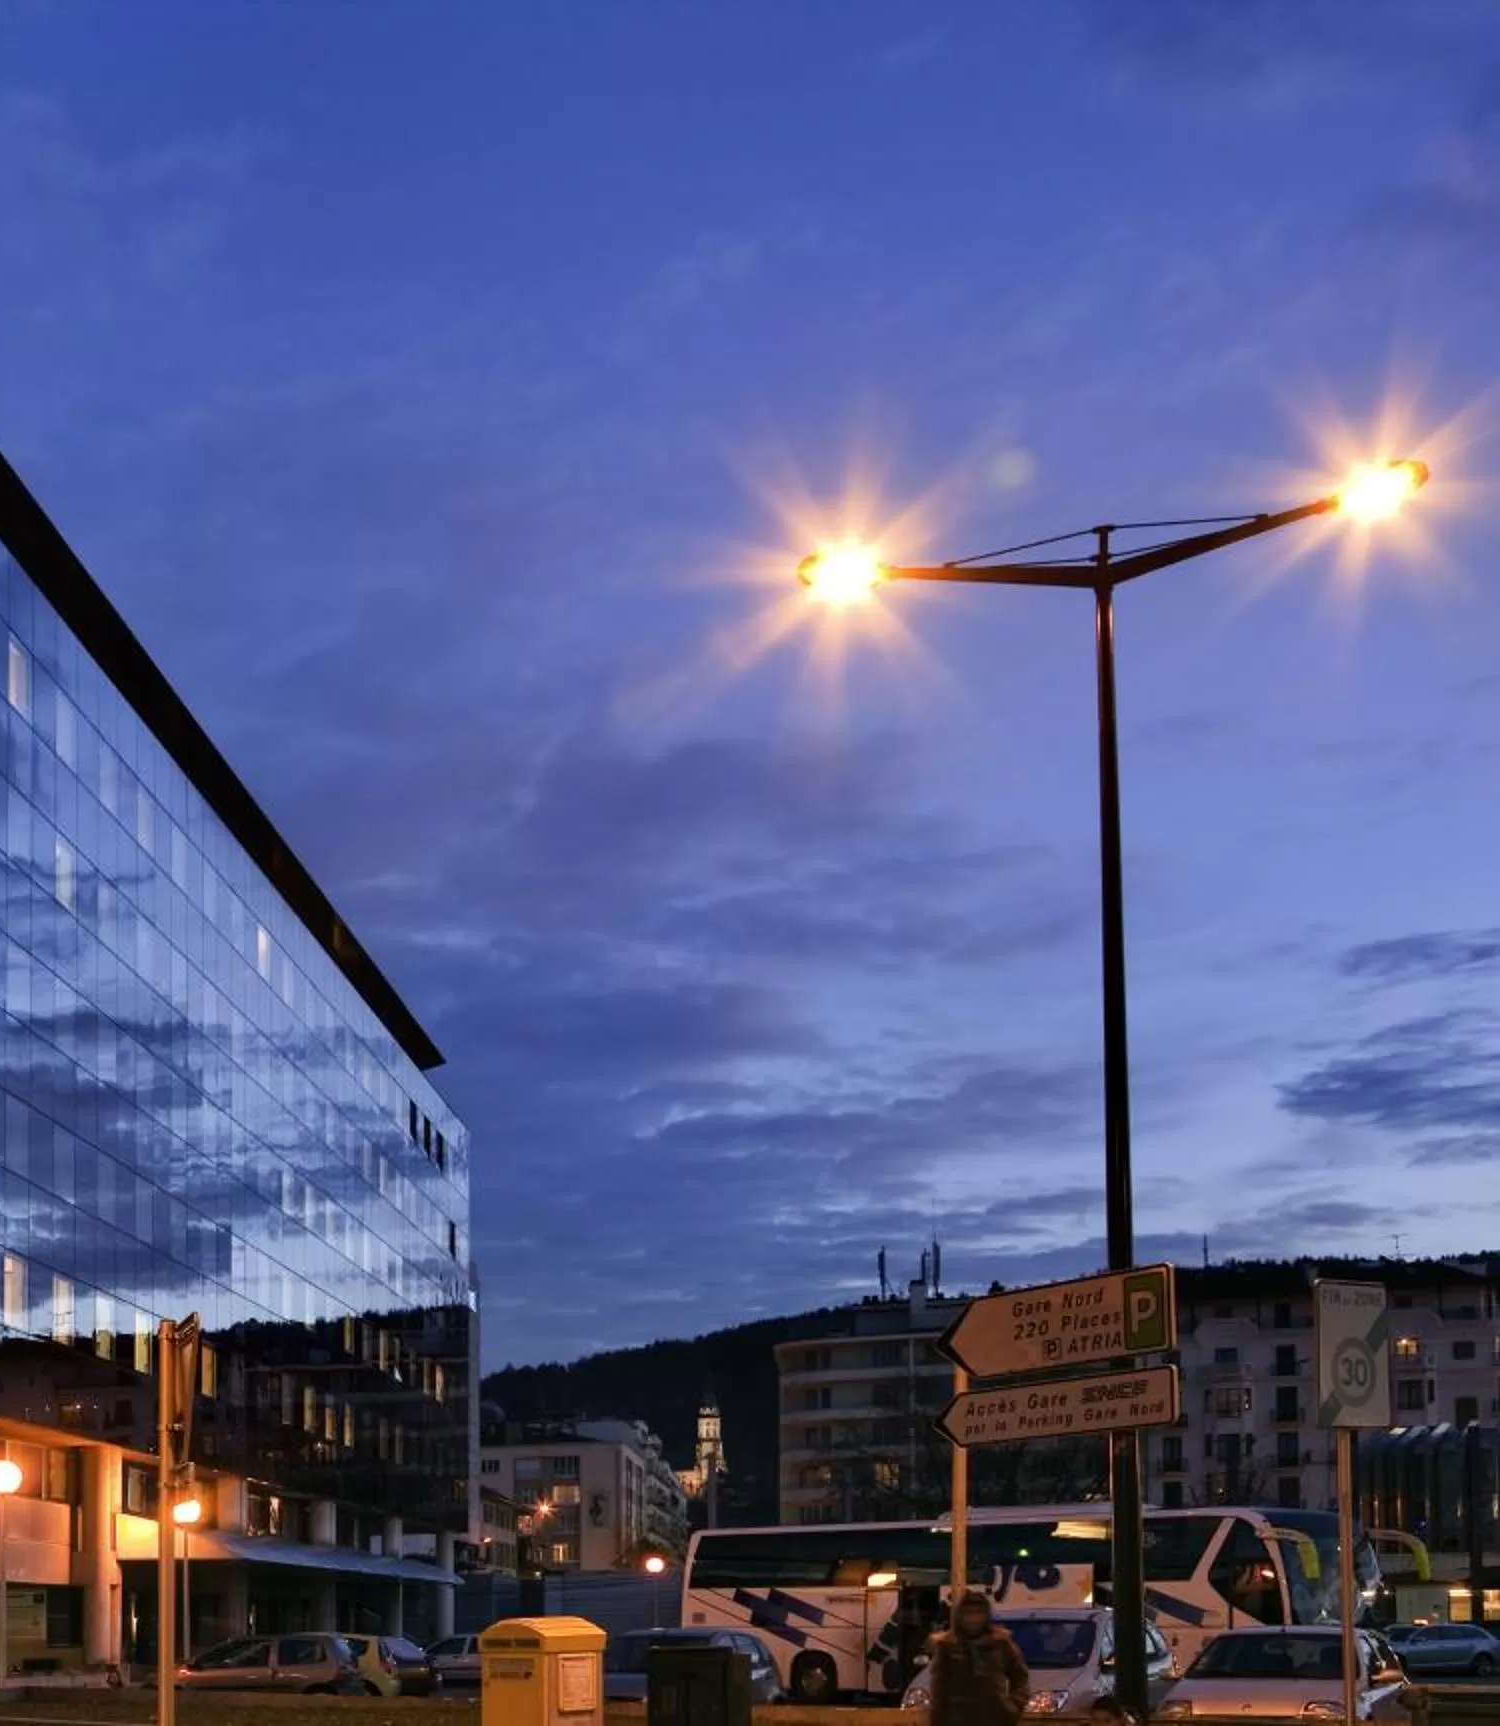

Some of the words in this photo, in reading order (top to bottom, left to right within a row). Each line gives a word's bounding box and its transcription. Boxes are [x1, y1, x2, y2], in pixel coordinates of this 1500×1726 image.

[1012, 1299, 1052, 1318] Gare
[1062, 1287, 1105, 1309] Nord
[1130, 1290, 1158, 1333] P
[1013, 1320, 1049, 1341] 220
[1061, 1311, 1123, 1332] Places
[1067, 1331, 1123, 1354] ATRIA
[1341, 1357, 1368, 1386] 30
[1018, 1413, 1073, 1429] Parking
[1084, 1408, 1118, 1422] Gare
[1129, 1401, 1165, 1417] Nord
[1028, 1393, 1069, 1410] Gare
